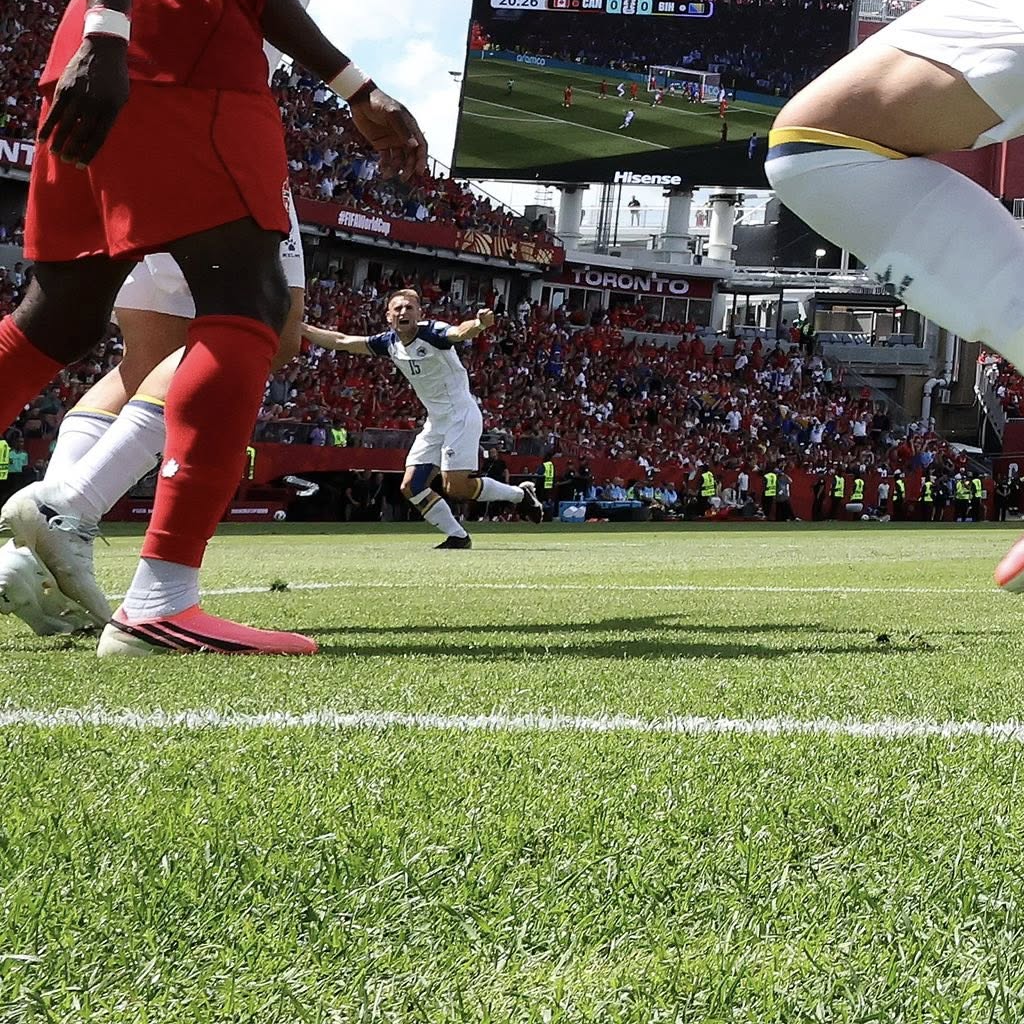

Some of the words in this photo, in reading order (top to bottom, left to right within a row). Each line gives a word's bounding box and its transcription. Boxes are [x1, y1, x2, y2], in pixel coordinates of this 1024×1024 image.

[658, 1, 675, 12] BIH
[516, 54, 546, 66] aramco
[613, 171, 681, 184] Hisense
[571, 268, 689, 294] TORONTO
[408, 359, 421, 376] 15
